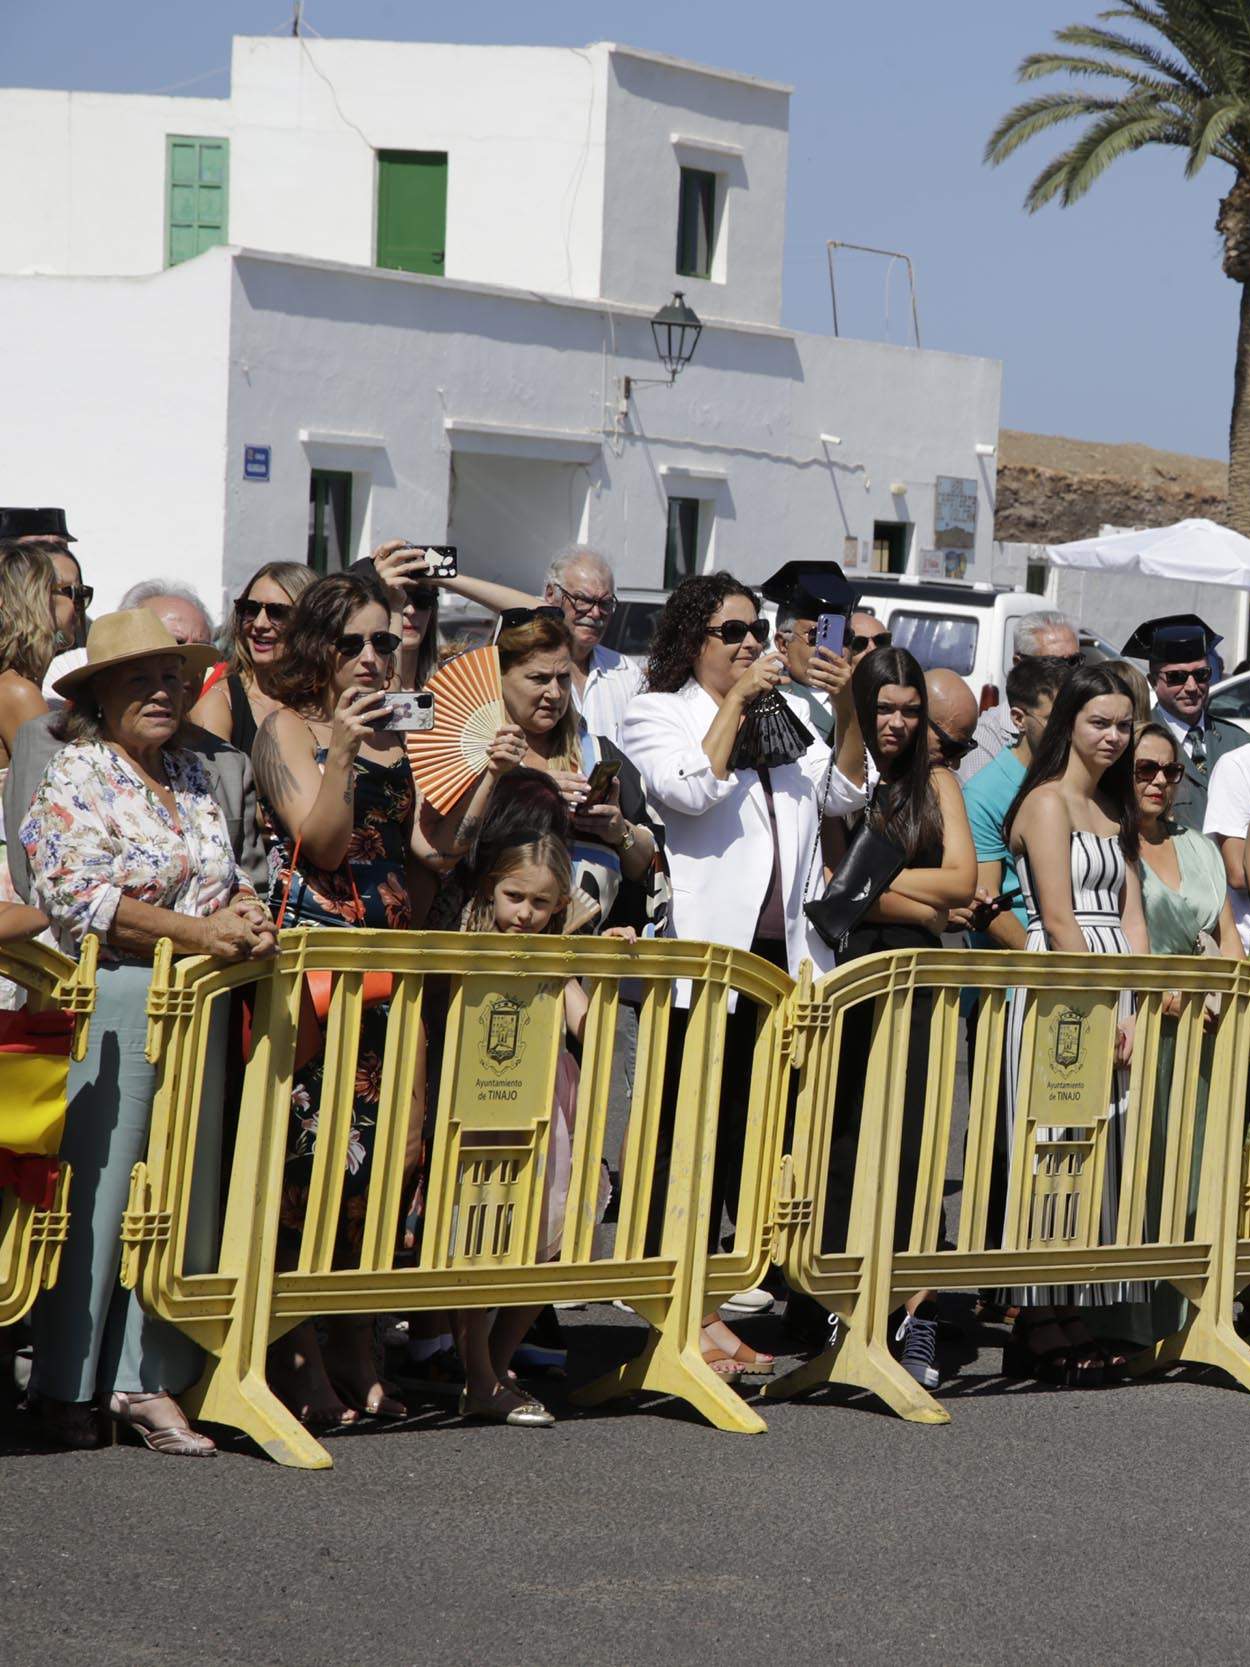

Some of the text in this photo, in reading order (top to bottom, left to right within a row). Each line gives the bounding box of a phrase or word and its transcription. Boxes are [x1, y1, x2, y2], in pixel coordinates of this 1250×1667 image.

[476, 1078, 522, 1089] Ayuntamiento
[1047, 1082, 1084, 1090] Ayuntamiento
[478, 1090, 517, 1100] de TINAJO
[1049, 1092, 1080, 1101] de TINAJO
